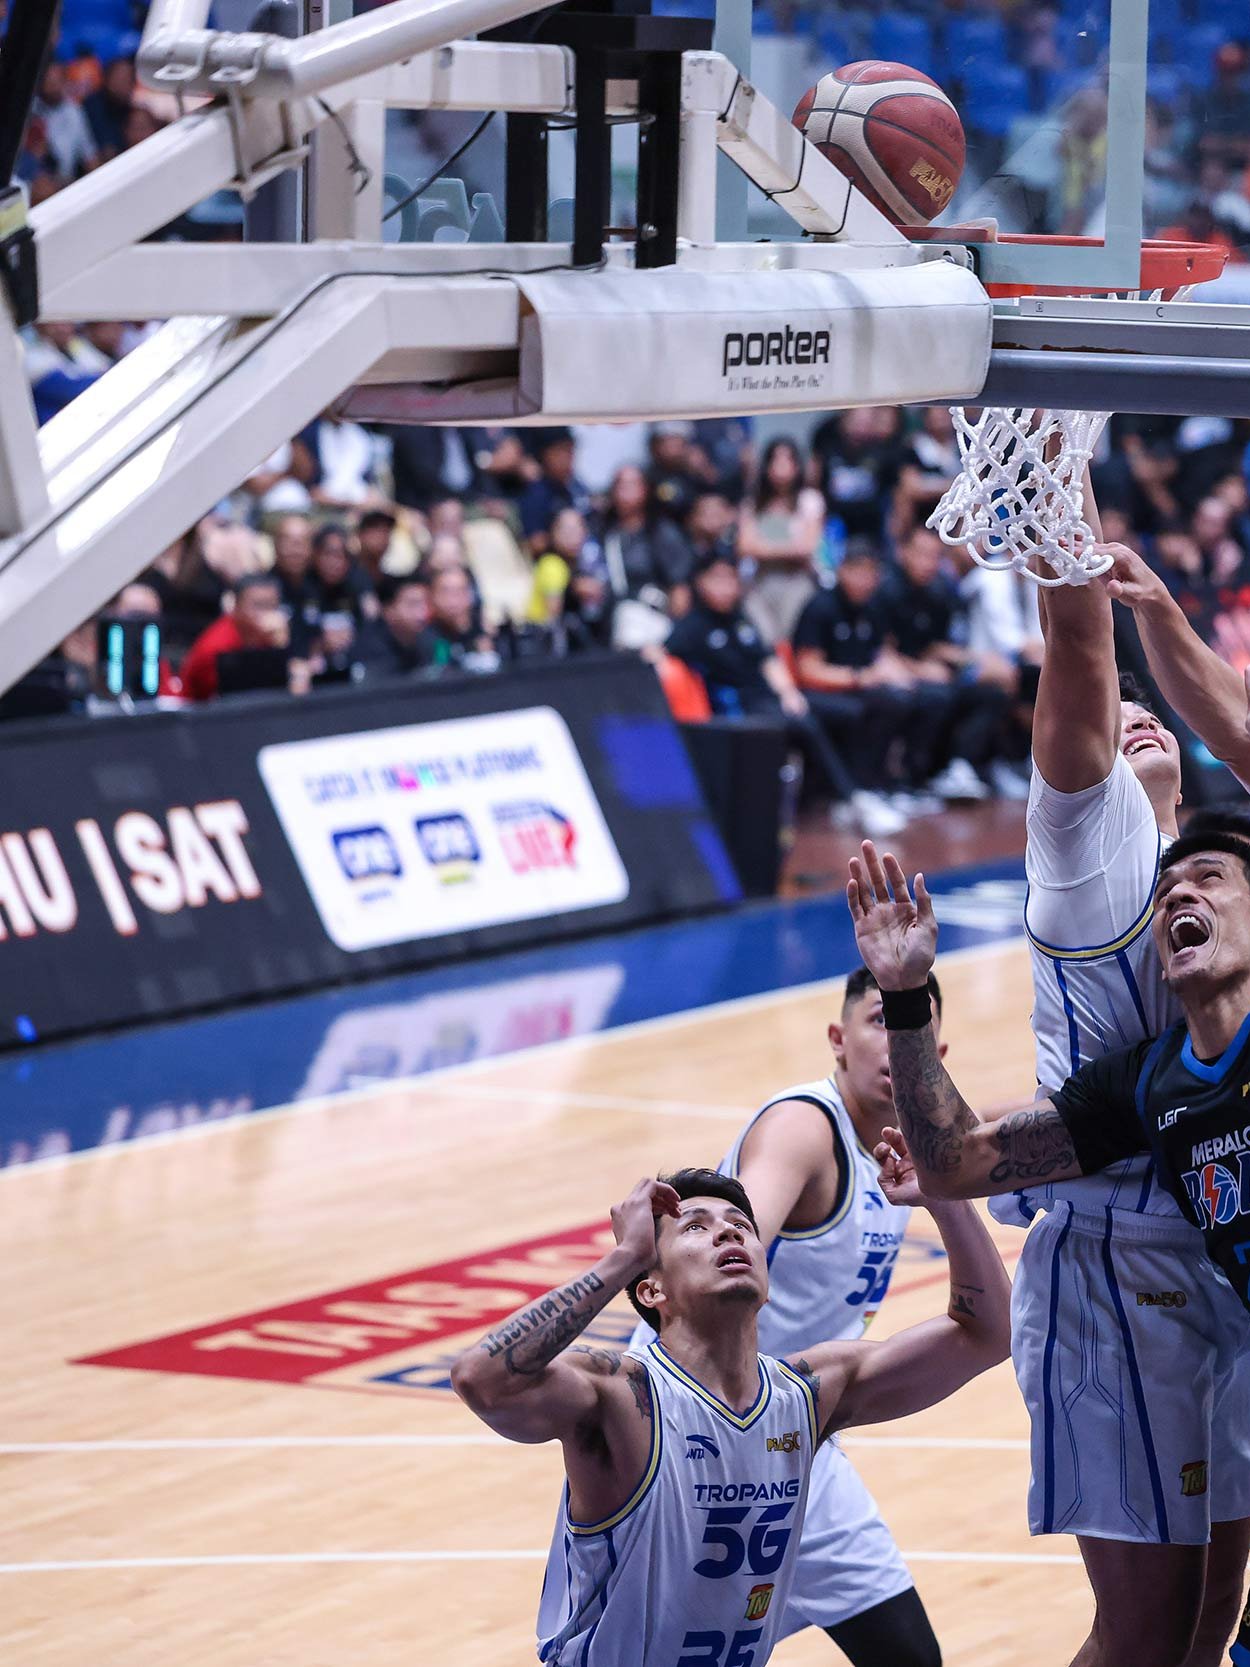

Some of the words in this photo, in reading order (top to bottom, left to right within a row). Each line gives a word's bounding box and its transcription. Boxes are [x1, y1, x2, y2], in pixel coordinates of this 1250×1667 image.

[115, 799, 262, 914] SAT
[693, 1478, 800, 1503] TROPANG
[692, 1501, 796, 1580] 5G
